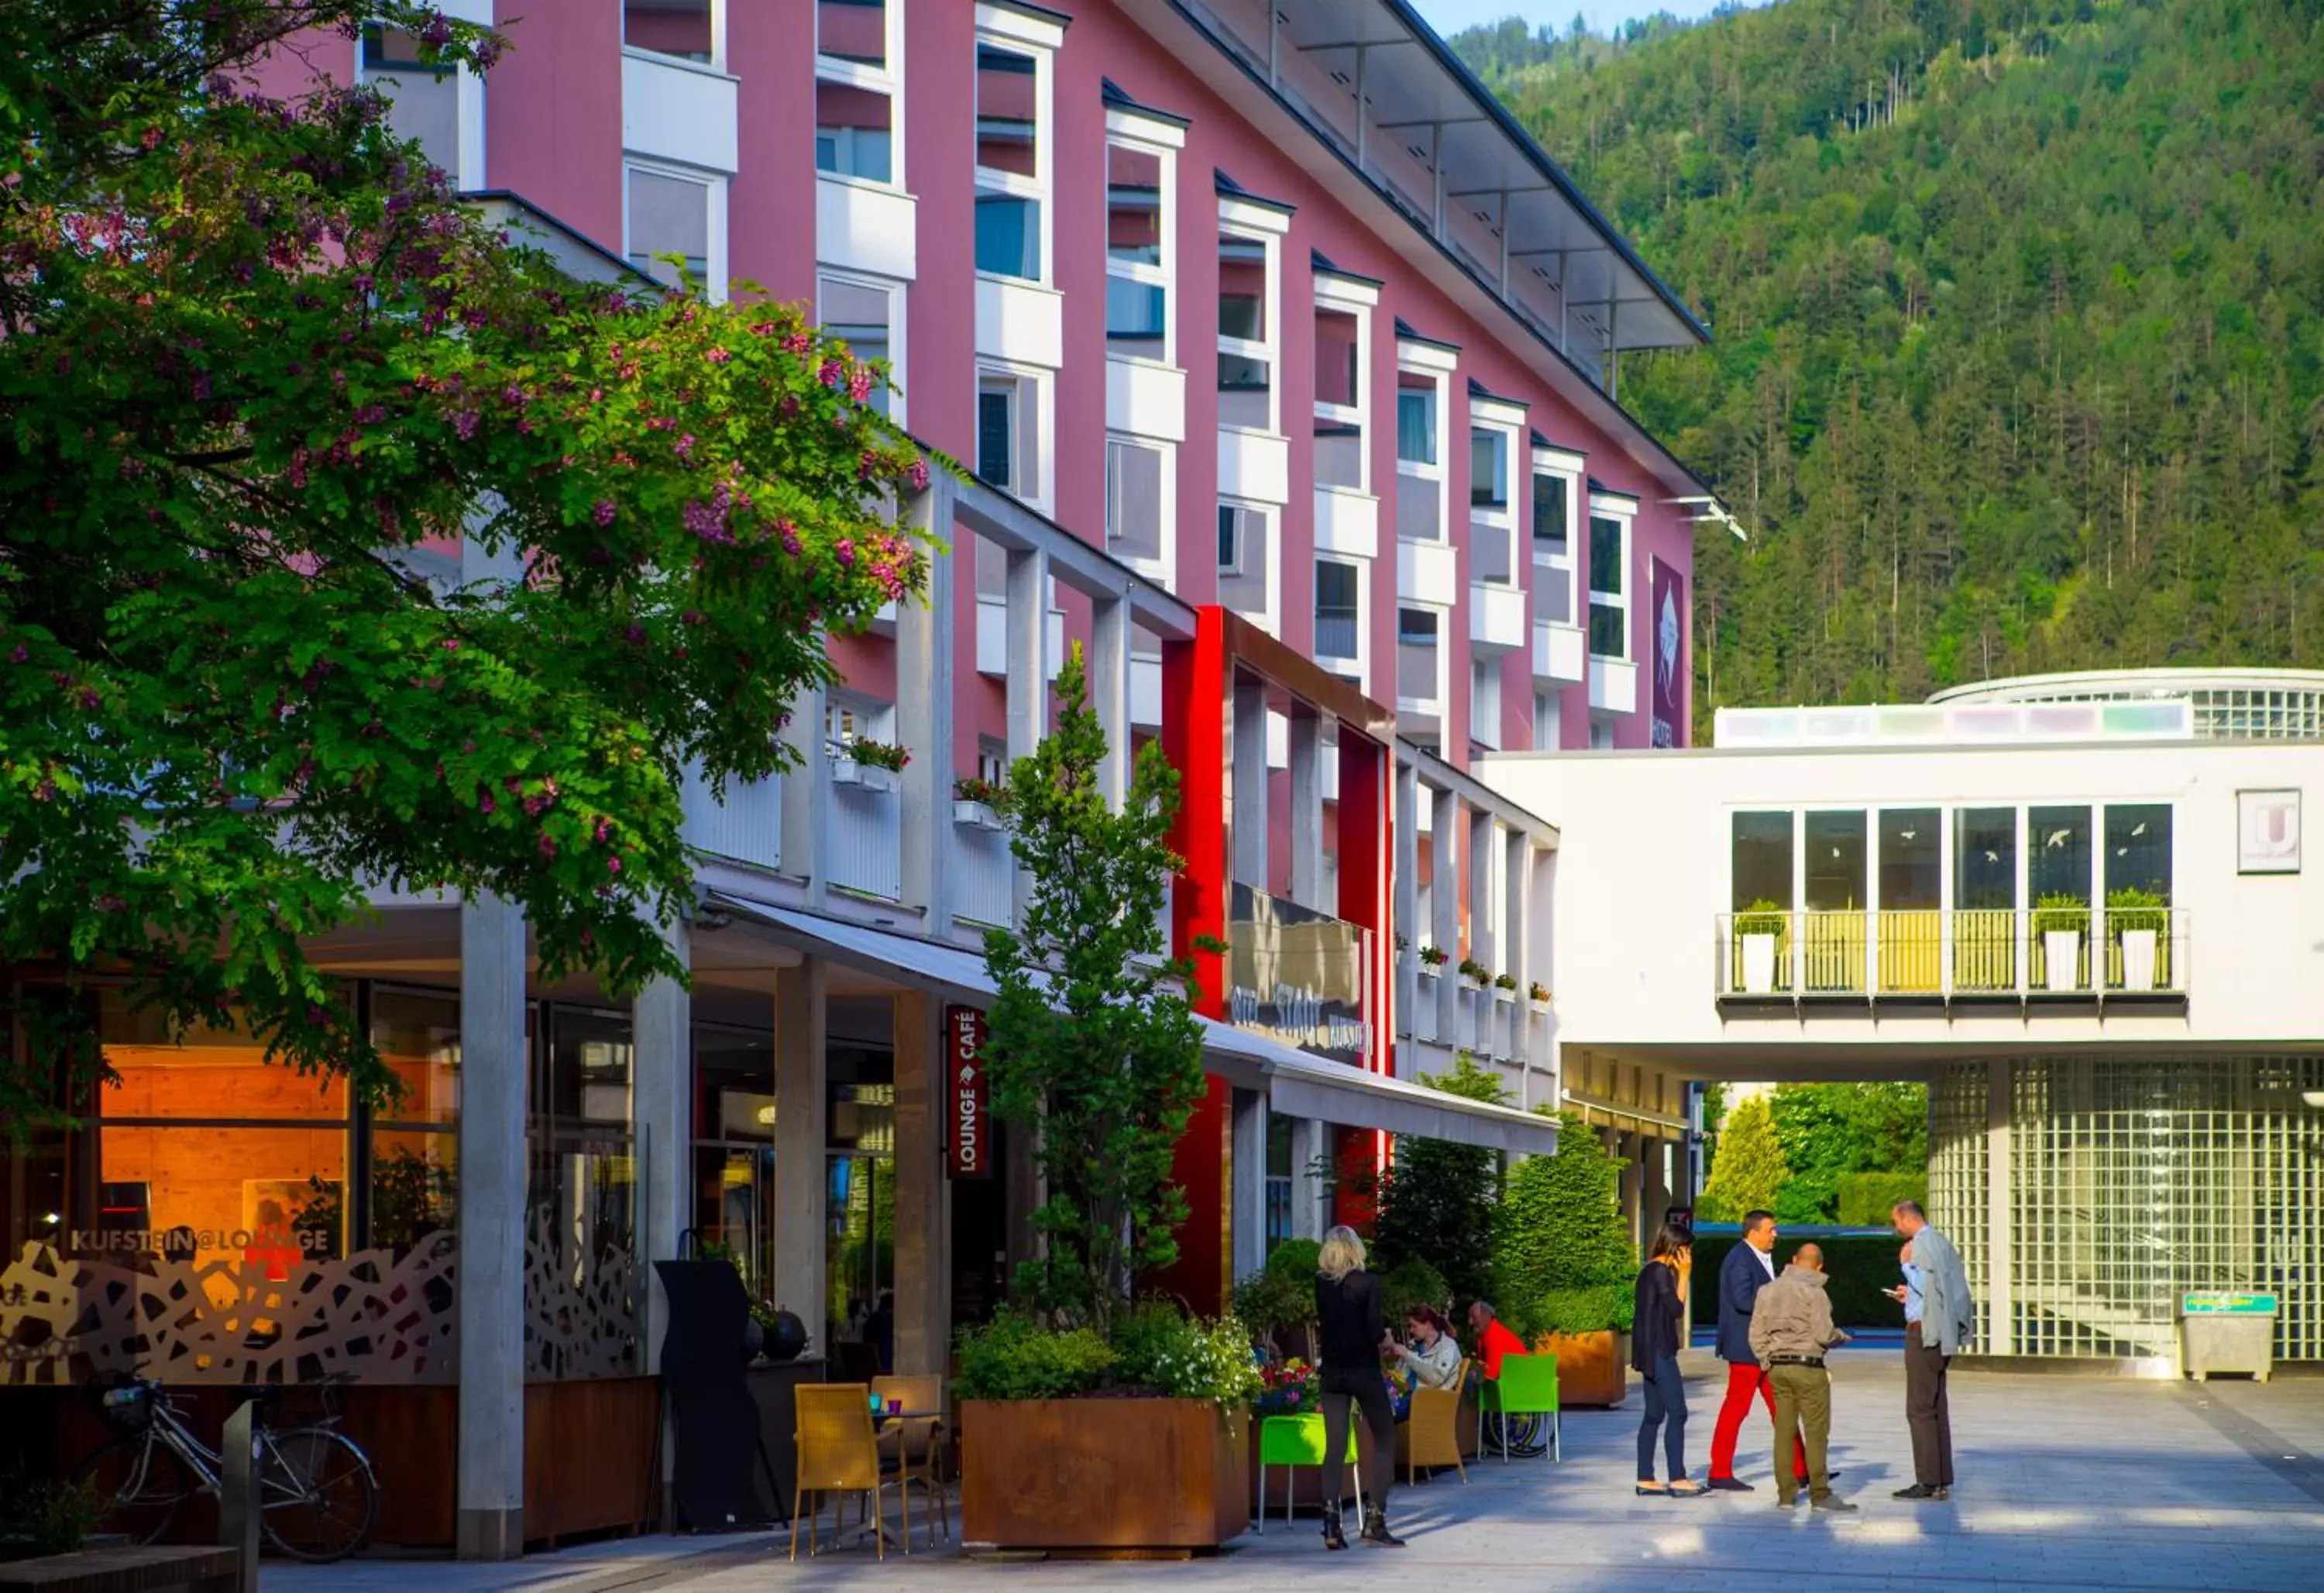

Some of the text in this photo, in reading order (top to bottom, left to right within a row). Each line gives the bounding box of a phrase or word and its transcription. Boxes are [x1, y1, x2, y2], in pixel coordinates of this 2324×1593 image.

[955, 1010, 976, 1172] LOUNGE CAFÉ
[71, 1229, 328, 1251] KUFSTEIN@LOUNGE
